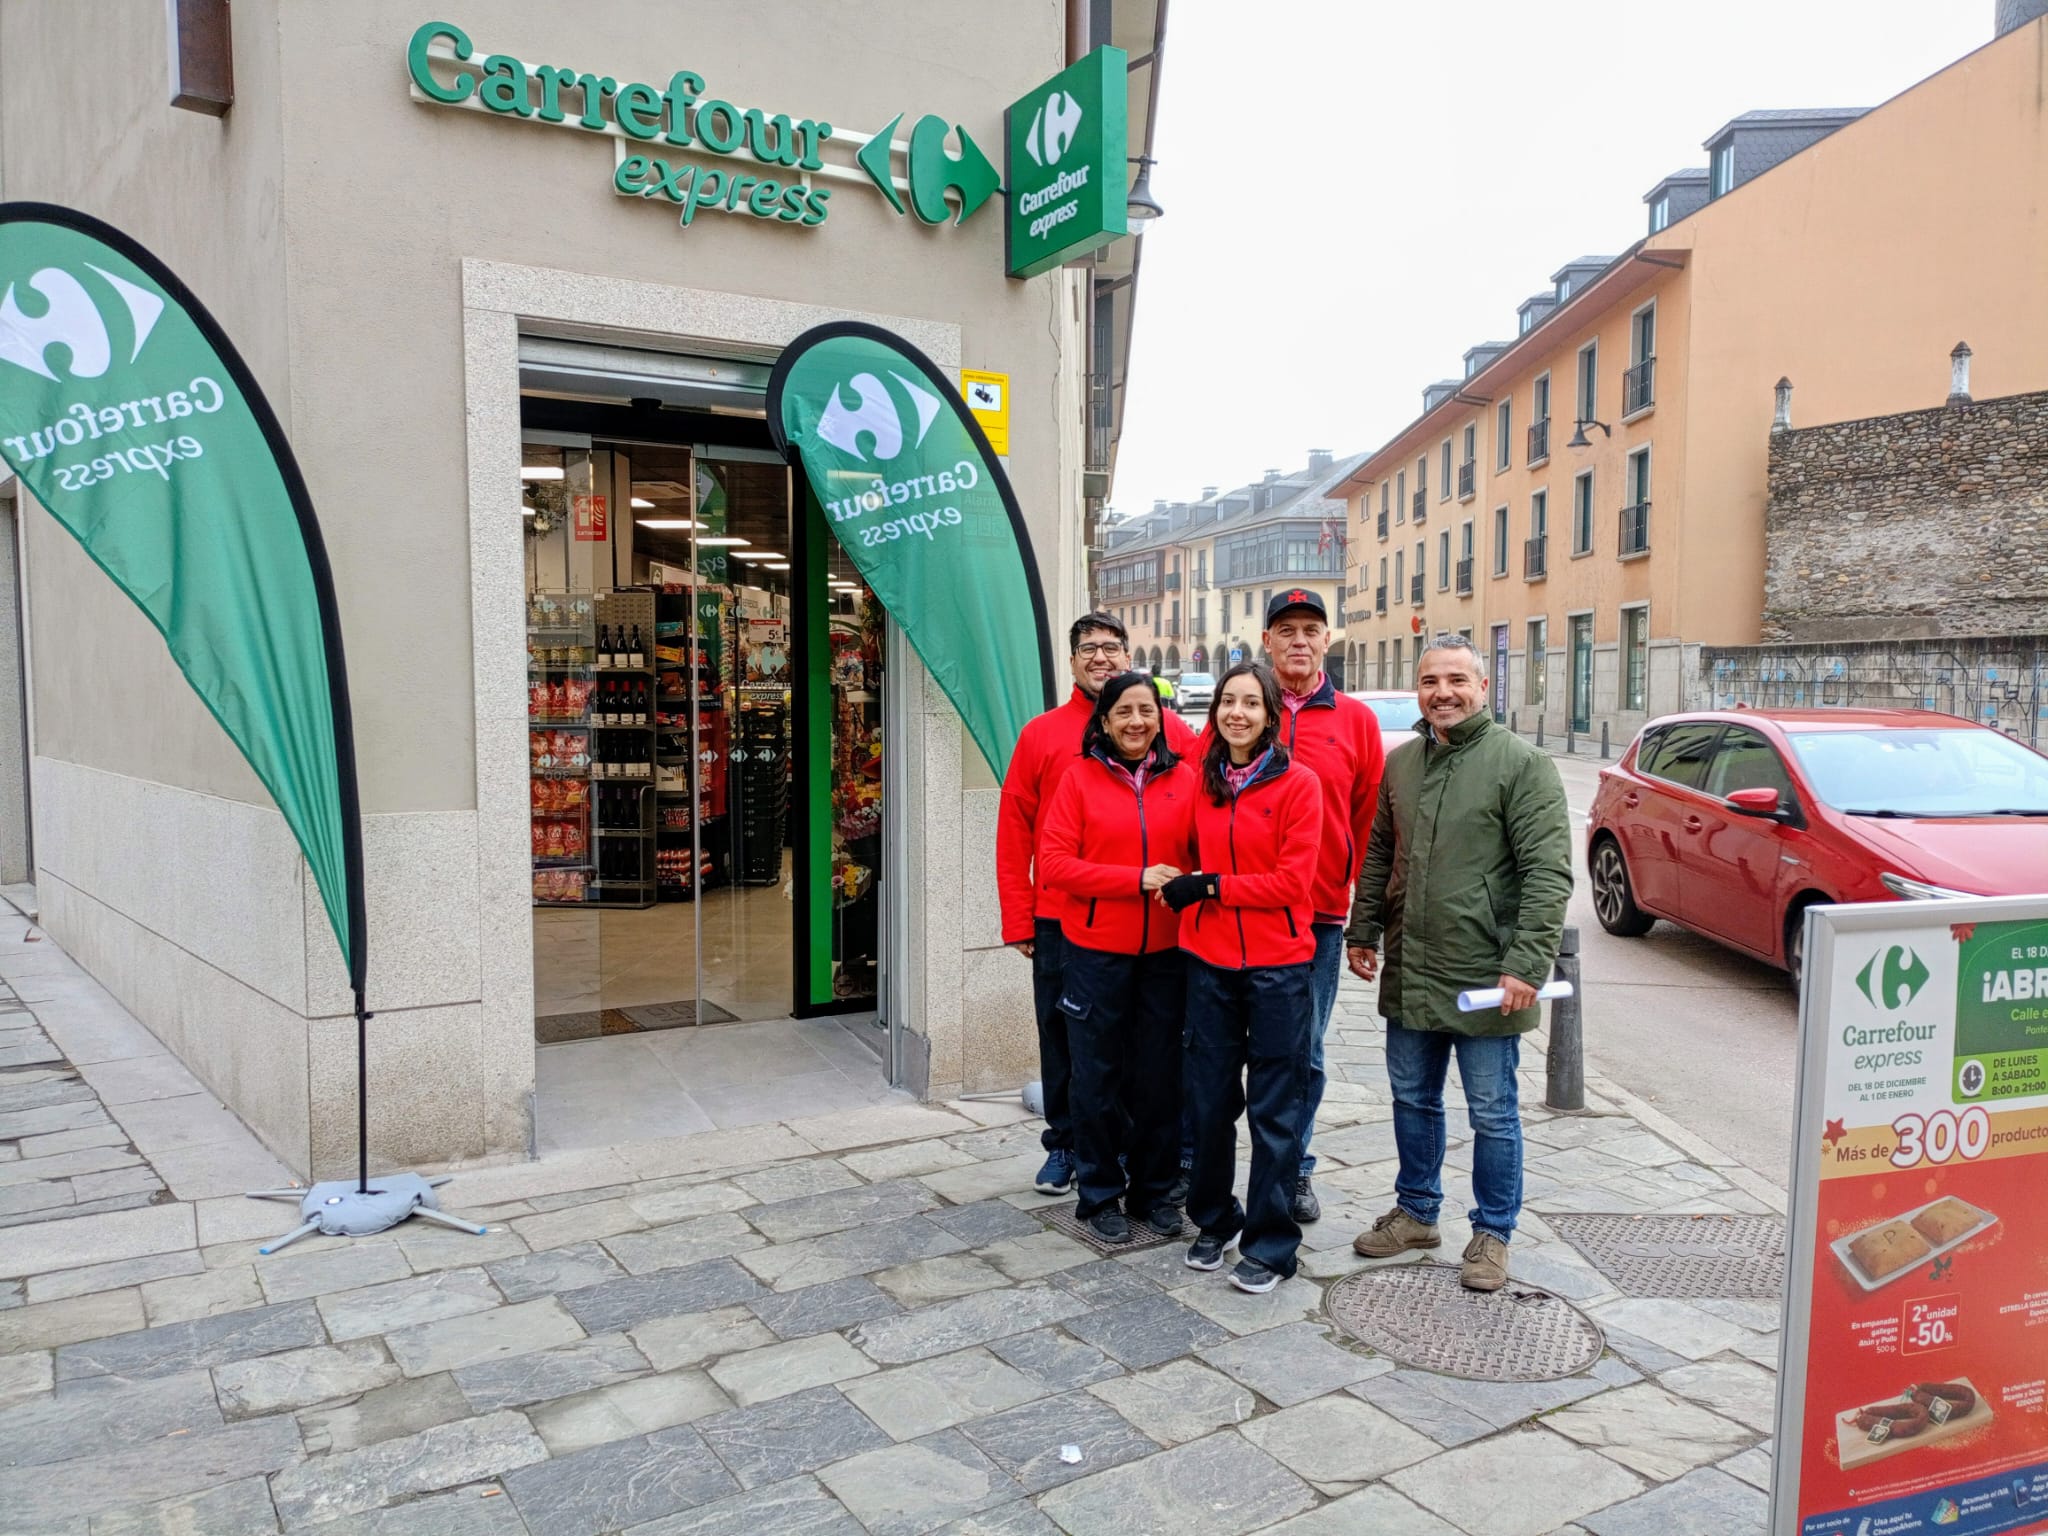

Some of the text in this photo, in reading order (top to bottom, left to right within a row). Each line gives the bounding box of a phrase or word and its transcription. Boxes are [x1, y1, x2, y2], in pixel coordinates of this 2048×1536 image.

[407, 21, 831, 171] Carrefour
[615, 153, 831, 228] express
[1019, 165, 1090, 216] Carrefour
[1029, 199, 1078, 240] express
[2011, 945, 2048, 959] EL 18 D
[2010, 1007, 2040, 1022] Calle
[1842, 1021, 1937, 1047] Carrefour
[1853, 1049, 1923, 1073] express
[1993, 1055, 2038, 1068] DE LUNES
[1848, 1076, 1927, 1092] DEL 18 DE DICIEMBRE
[1992, 1068, 2041, 1082] A SÁBADO
[1860, 1093, 1869, 1102] AL
[1876, 1092, 1887, 1100] DE
[1888, 1089, 1914, 1099] ENERO
[1992, 1080, 2047, 1095] 8:00 a 21:00
[1836, 1145, 1867, 1163] Más
[1870, 1142, 1889, 1160] de
[1889, 1105, 1991, 1169] 300
[1912, 1304, 1957, 1322] 2ª unidad
[1909, 1320, 1953, 1346] -50%
[1874, 1518, 1888, 1526] Usa
